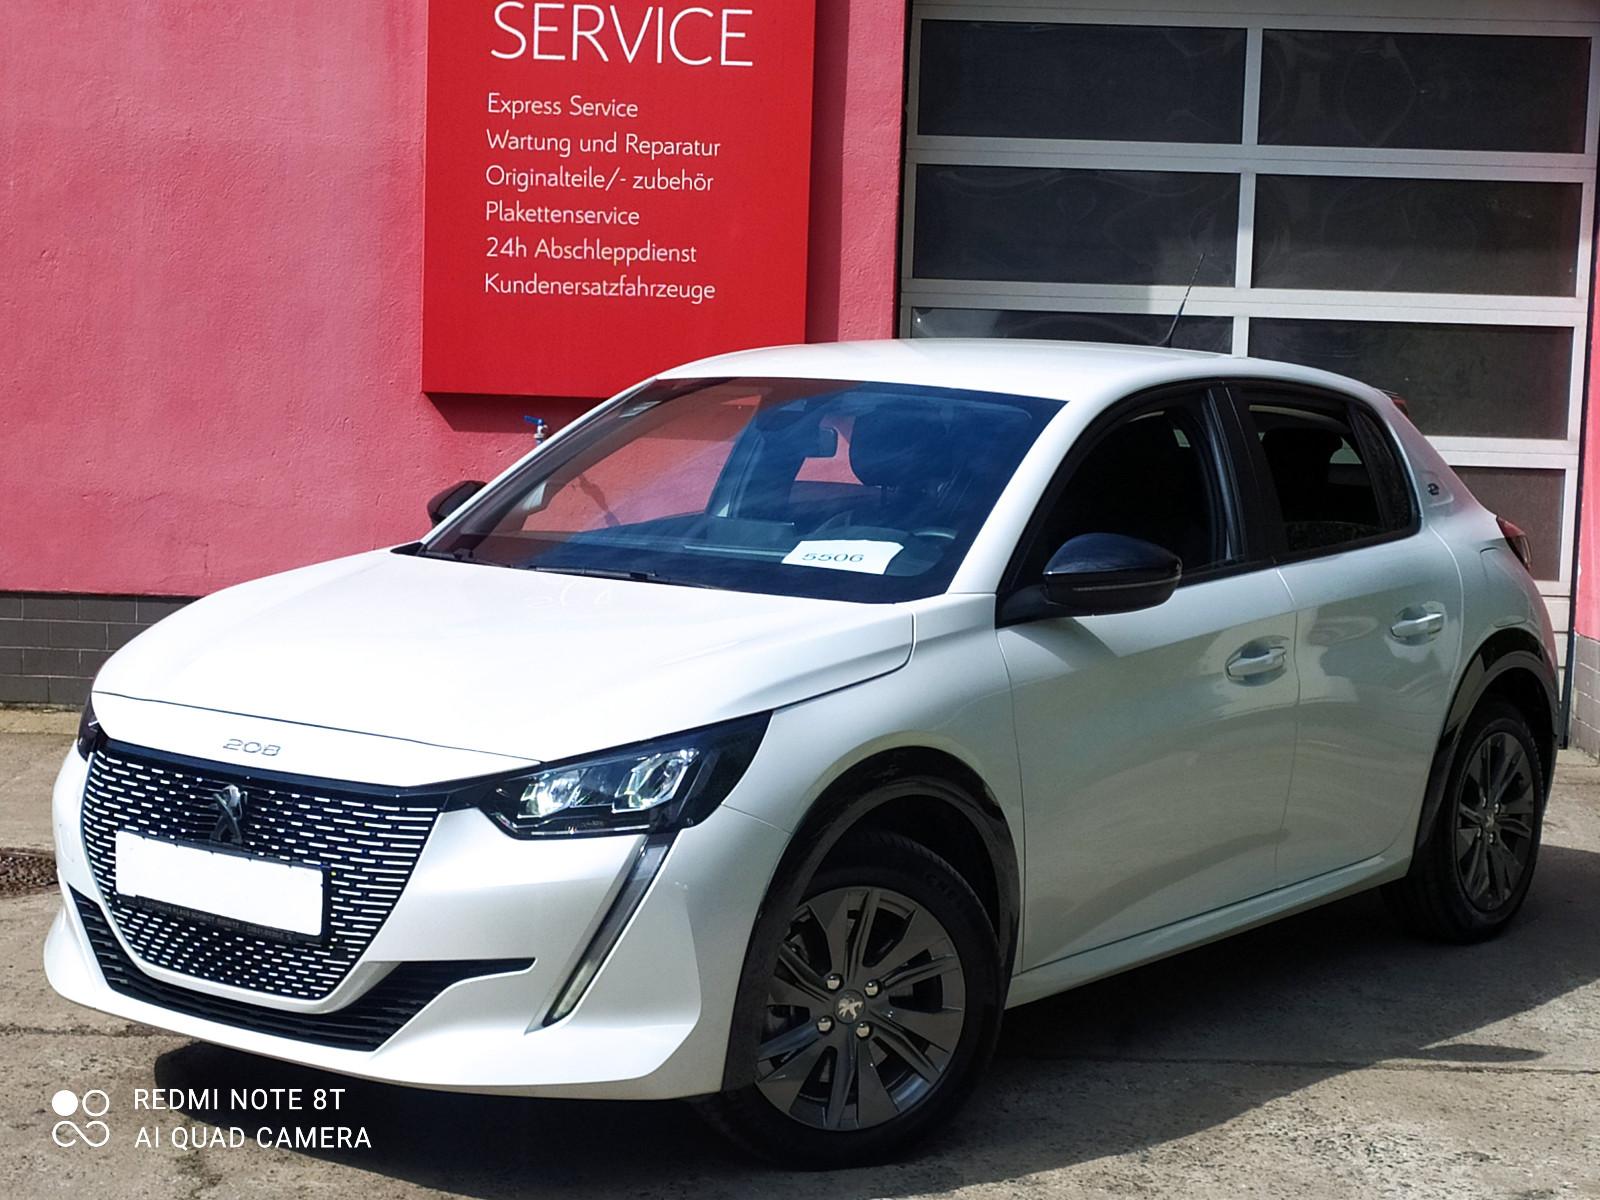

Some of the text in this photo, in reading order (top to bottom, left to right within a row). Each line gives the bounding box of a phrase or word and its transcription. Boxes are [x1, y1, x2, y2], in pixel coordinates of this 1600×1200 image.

[491, 1, 752, 66] SERVICE
[489, 93, 638, 119] Express Service
[487, 129, 720, 160] Wartung und Reparatur
[486, 165, 713, 192] Originalteile/- zubehör
[487, 200, 639, 225] Plakettenservice
[487, 237, 696, 266] 24h Abschleppdienst
[486, 273, 715, 304] Kundenersatzfahrzeuge
[801, 552, 864, 563] 5506
[222, 738, 281, 756] 208
